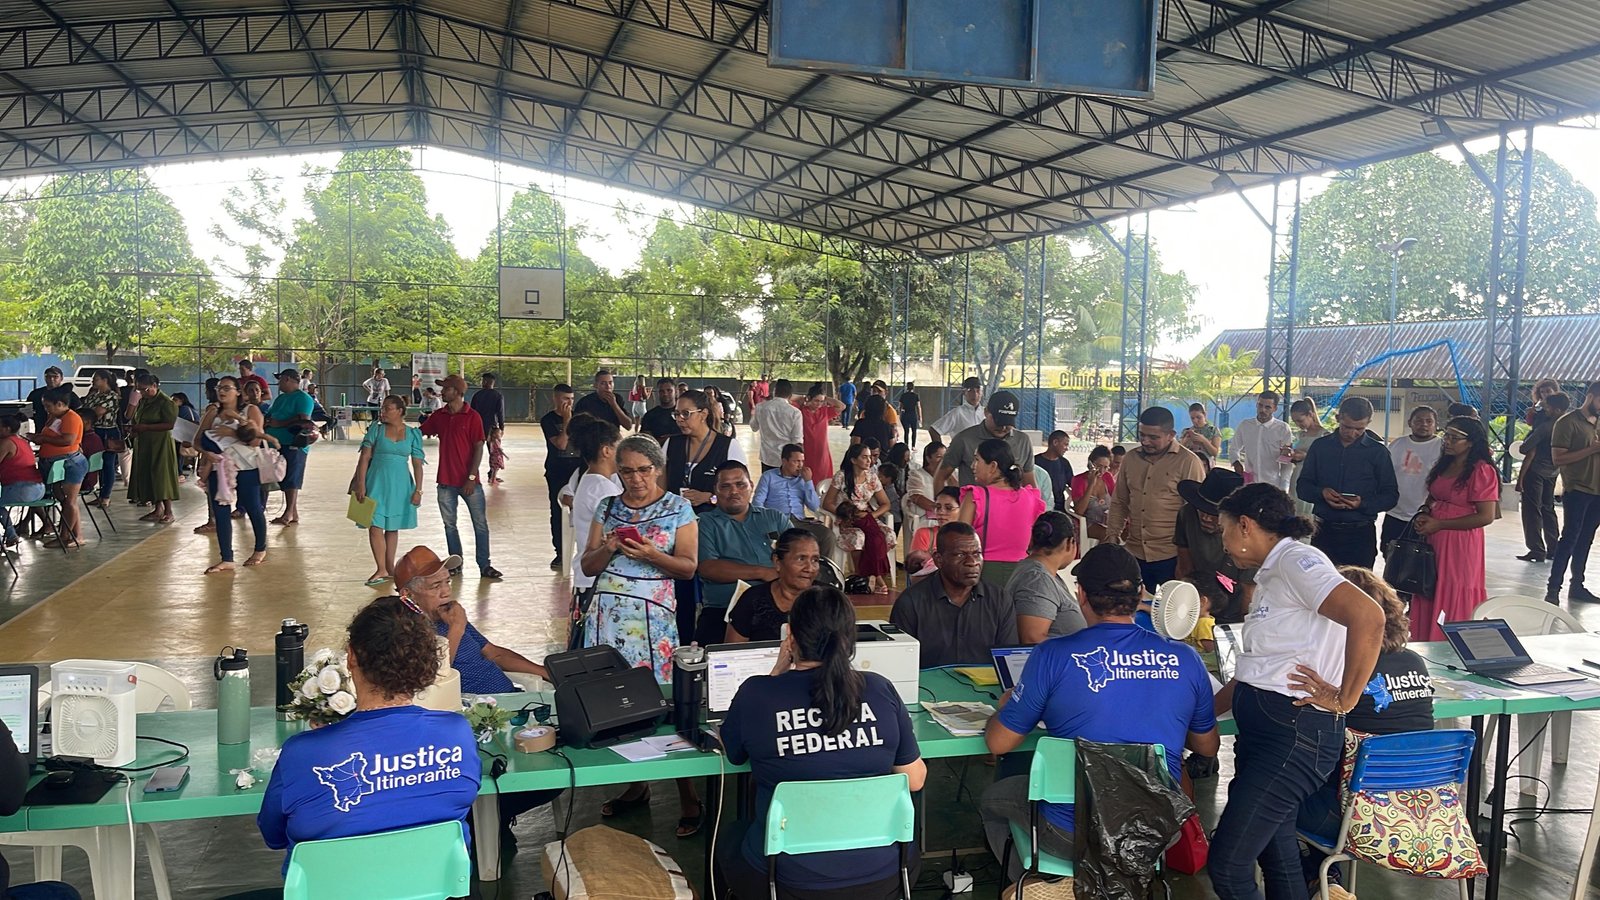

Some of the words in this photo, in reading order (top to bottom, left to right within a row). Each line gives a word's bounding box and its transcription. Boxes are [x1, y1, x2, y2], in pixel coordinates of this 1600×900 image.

[1111, 649, 1179, 669] Justiça
[1115, 667, 1179, 679] Itinerante
[776, 702, 877, 732] RECA
[776, 726, 884, 757] FEDERAL
[370, 744, 462, 775] Justiça
[376, 765, 461, 791] Itinerante
